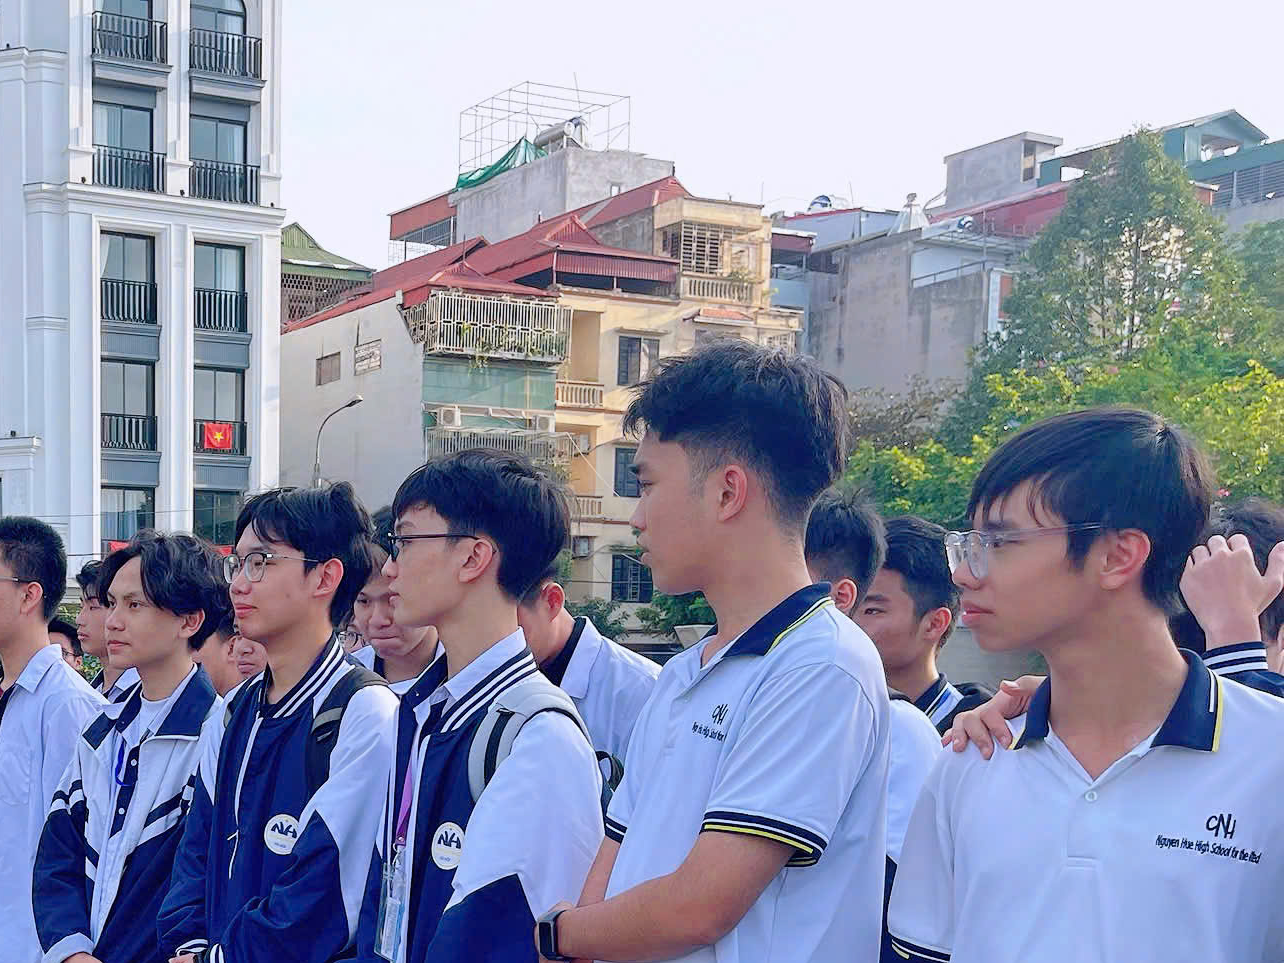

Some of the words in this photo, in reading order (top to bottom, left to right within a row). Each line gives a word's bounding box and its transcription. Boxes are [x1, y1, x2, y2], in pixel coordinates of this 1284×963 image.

[437, 831, 462, 849] NH
[1155, 834, 1180, 849] Nguyen
[1180, 838, 1194, 850] Hue
[1194, 840, 1210, 854] High
[1210, 842, 1232, 857] School
